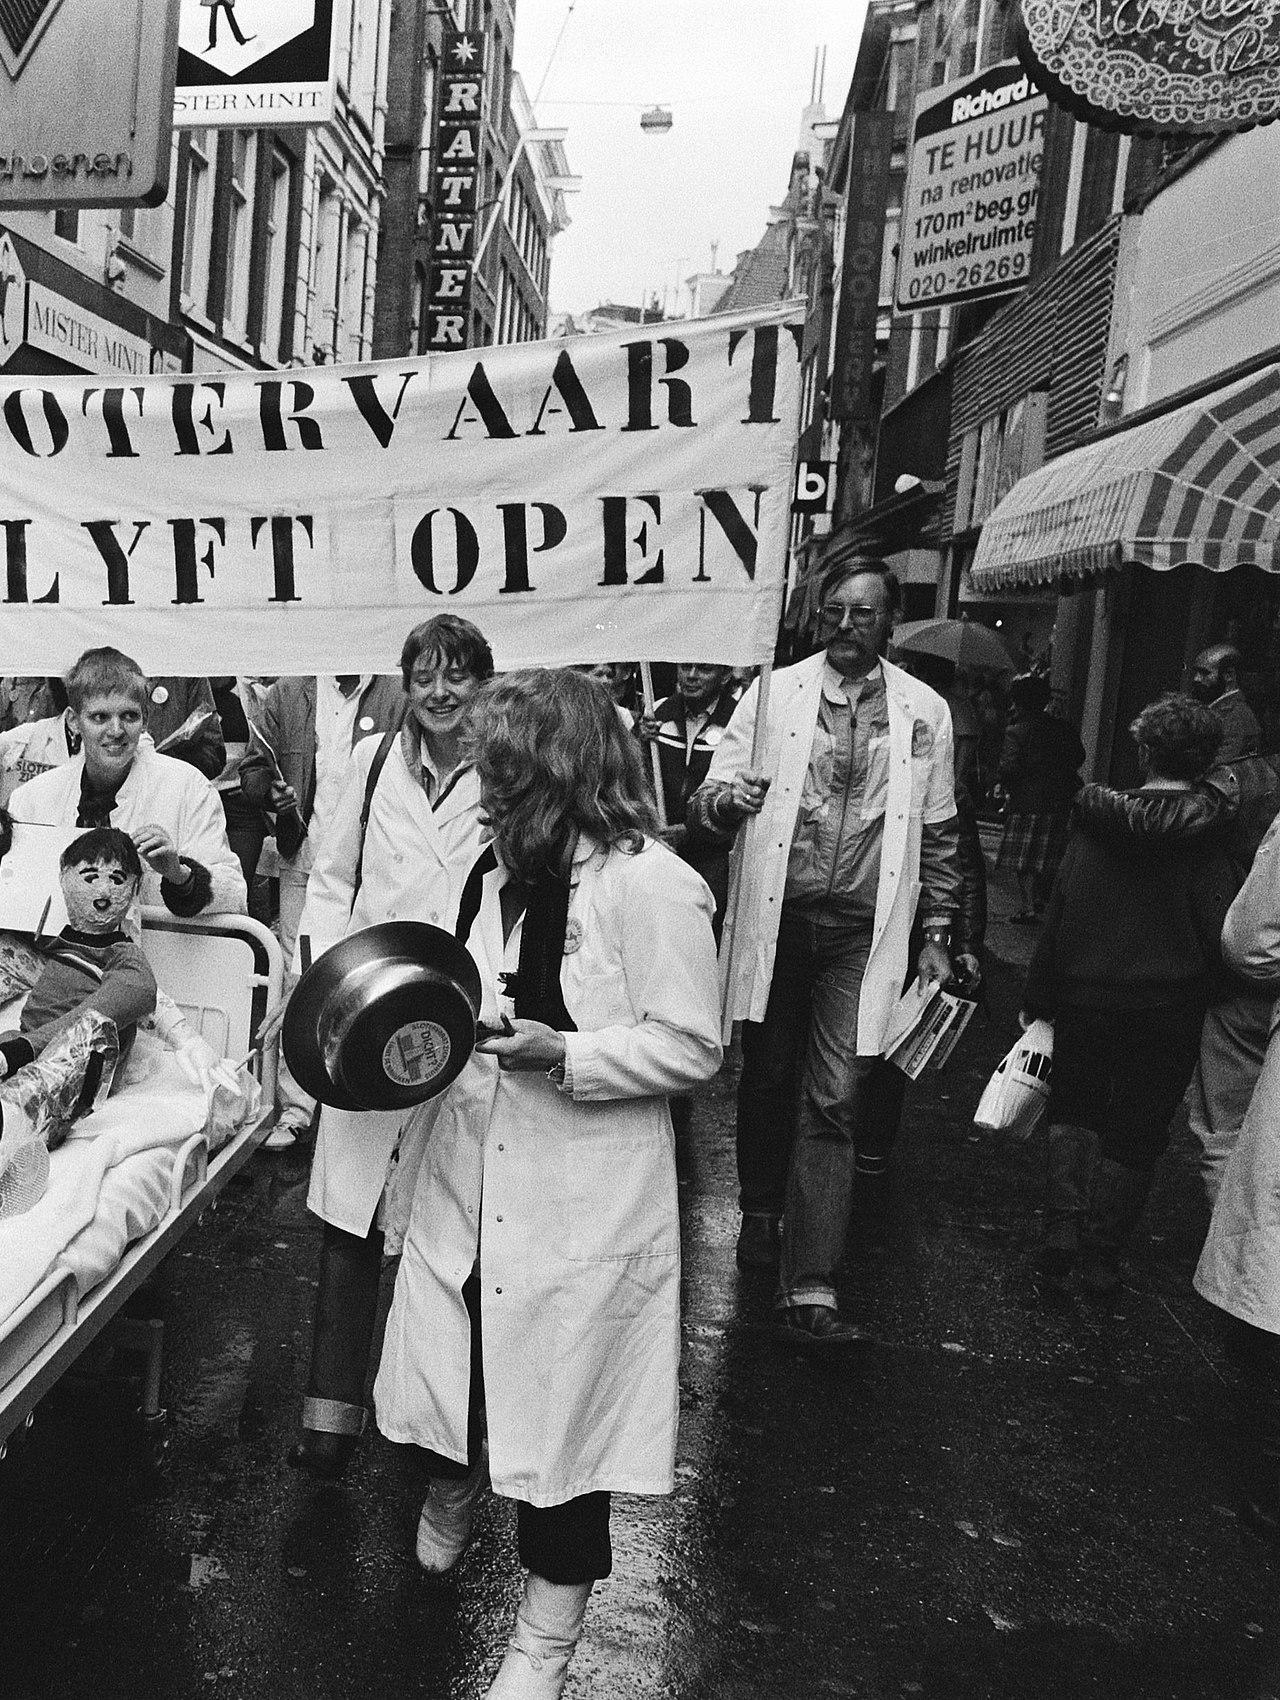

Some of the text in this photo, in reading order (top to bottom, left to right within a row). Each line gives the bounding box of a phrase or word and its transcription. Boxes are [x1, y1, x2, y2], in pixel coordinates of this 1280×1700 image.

[245, 91, 321, 109] MINIT
[951, 73, 1029, 124] Richard
[921, 149, 1044, 206] na renovatie
[926, 141, 956, 176] TE
[430, 82, 480, 343] RATNER
[913, 218, 1035, 268] winkelruimte
[909, 251, 1029, 300] 020-26269
[33, 300, 98, 360] MISTER
[410, 484, 770, 595] OPEN
